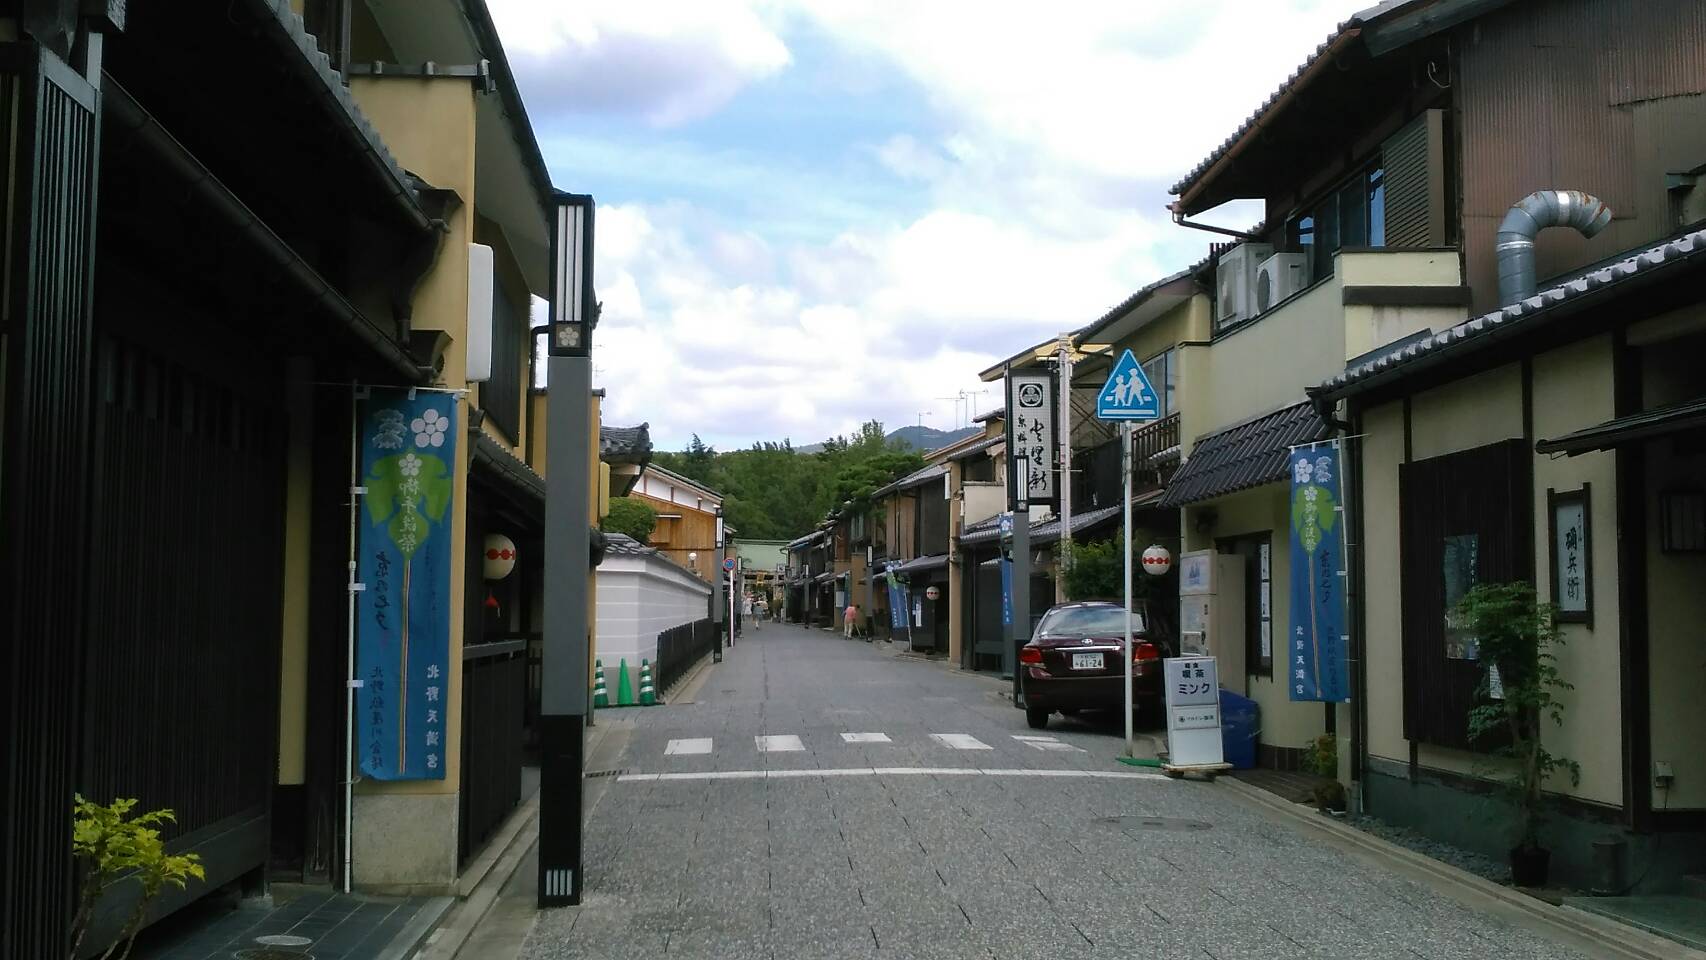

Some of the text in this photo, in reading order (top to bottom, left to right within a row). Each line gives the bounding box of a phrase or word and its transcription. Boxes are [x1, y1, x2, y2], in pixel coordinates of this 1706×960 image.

[1182, 669, 1205, 679] 喫茶
[1178, 683, 1210, 695] ミンク
